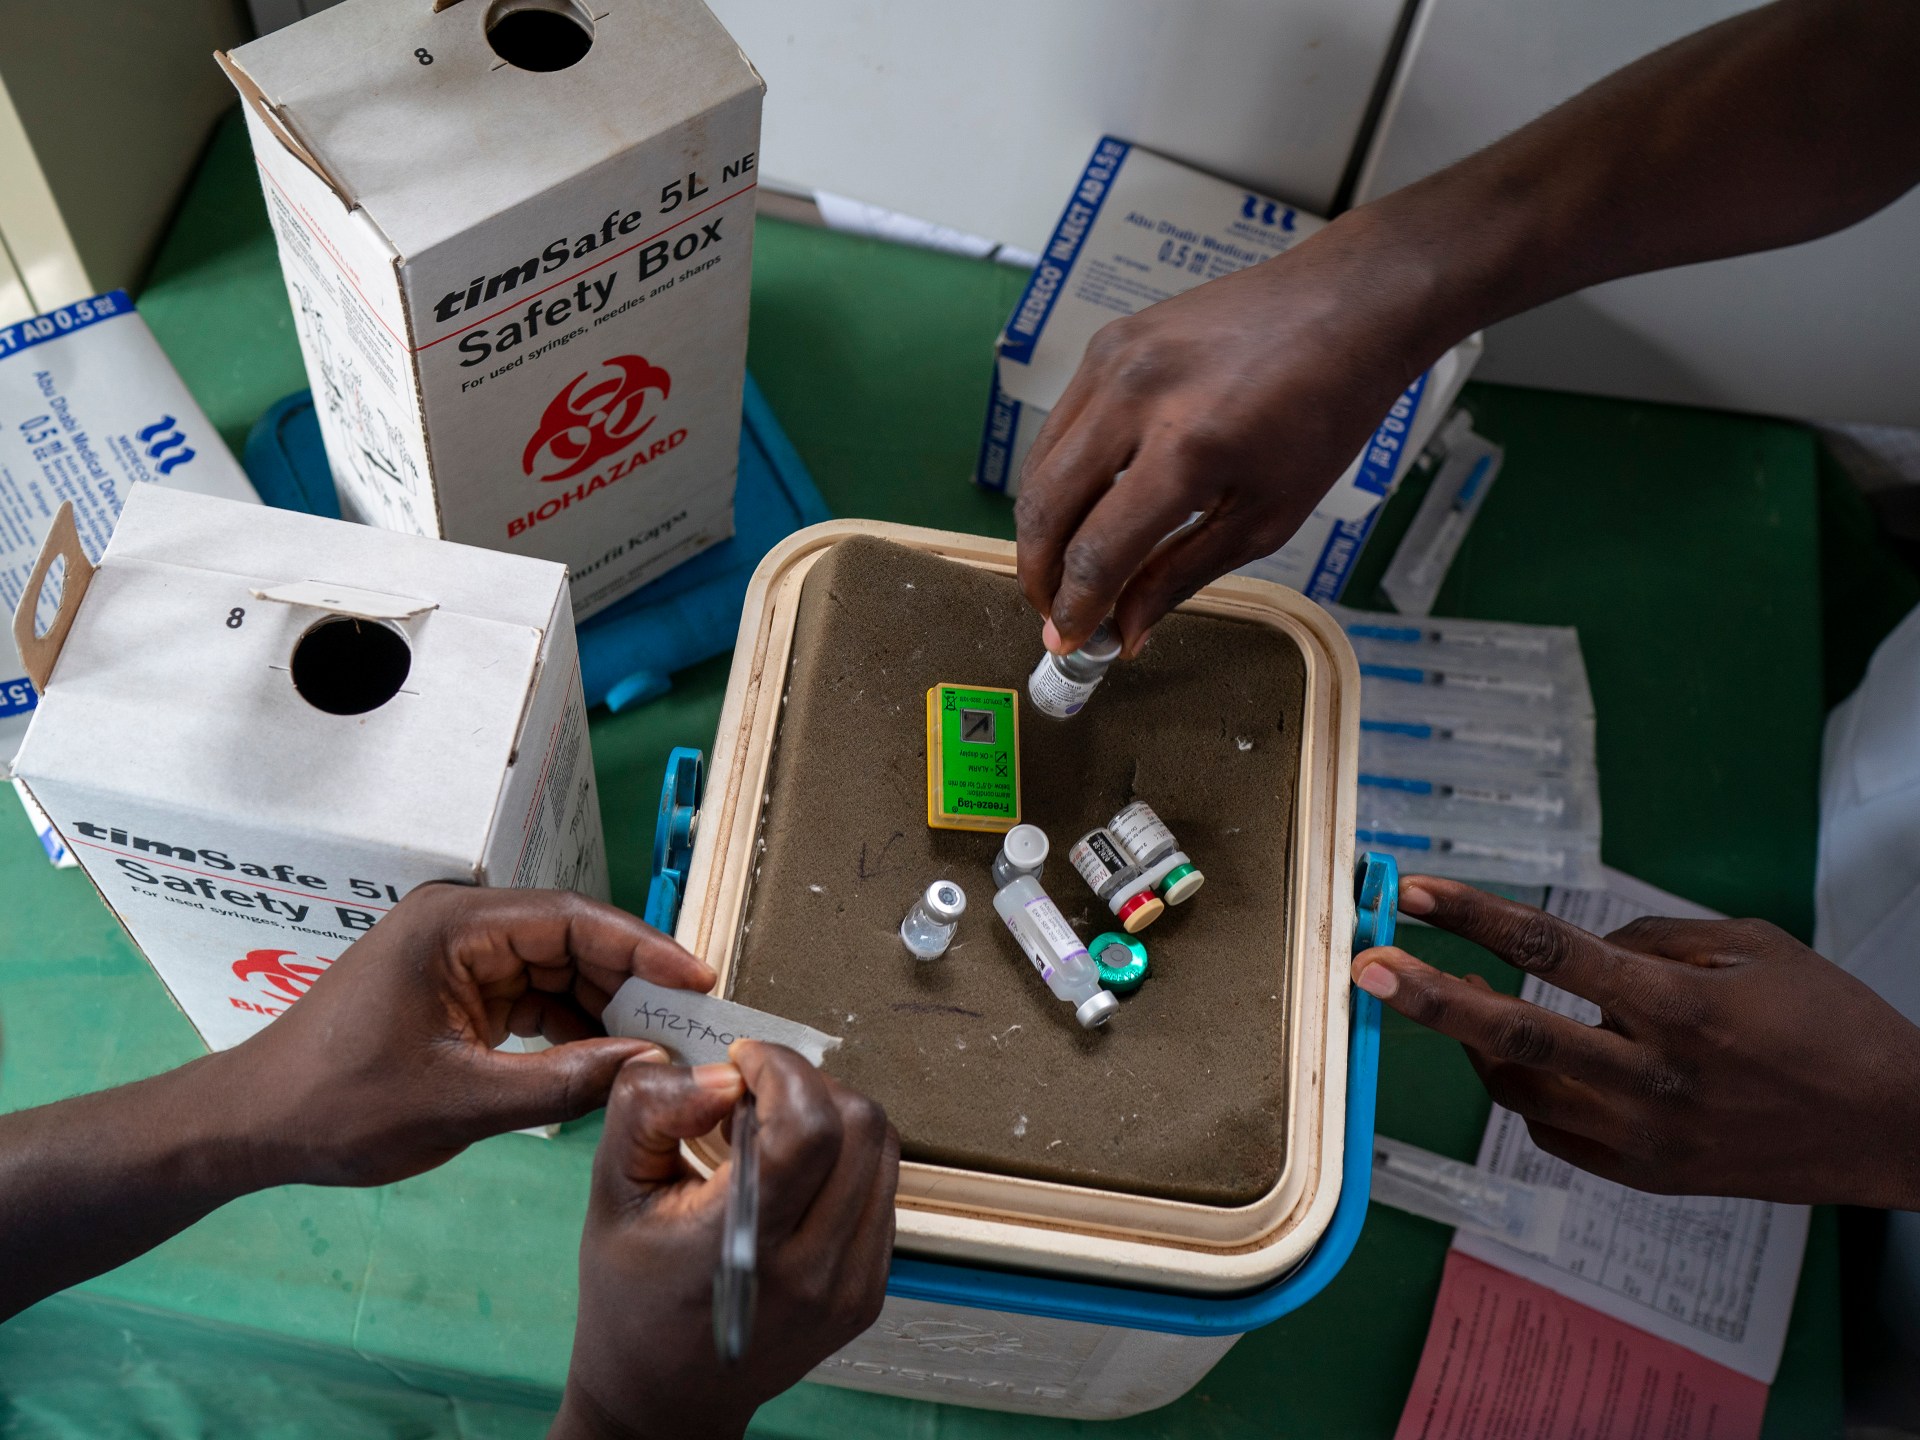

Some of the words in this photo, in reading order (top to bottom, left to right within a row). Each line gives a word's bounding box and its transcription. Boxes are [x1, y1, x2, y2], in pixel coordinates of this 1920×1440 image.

[414, 47, 434, 66] 8
[433, 208, 642, 323] timSafe
[659, 172, 708, 214] 5L
[722, 152, 755, 184] NE
[1051, 201, 1093, 262] INJECT
[22, 317, 56, 342] AD
[54, 302, 95, 330] 0.5
[459, 270, 618, 368] Safety
[638, 216, 724, 283] Box
[461, 375, 485, 393] For
[490, 356, 524, 381] used
[528, 326, 590, 361] syringes,
[593, 295, 646, 327] needles
[651, 276, 675, 299] and
[678, 254, 723, 287] sharps
[18, 414, 60, 446] 0.5
[33, 370, 57, 399] Abu
[49, 396, 78, 435] Dhabi
[71, 431, 104, 479] Medical
[99, 473, 126, 519] Devic
[507, 428, 688, 539] BIOHAZARD
[226, 607, 246, 629] 8
[960, 749, 979, 759] display
[968, 765, 989, 773] ALARM
[72, 821, 328, 891] timSafe
[115, 858, 310, 923] Safety
[131, 885, 159, 898] For
[164, 895, 205, 910] used
[210, 906, 287, 930] syringes,
[291, 924, 358, 943] needles
